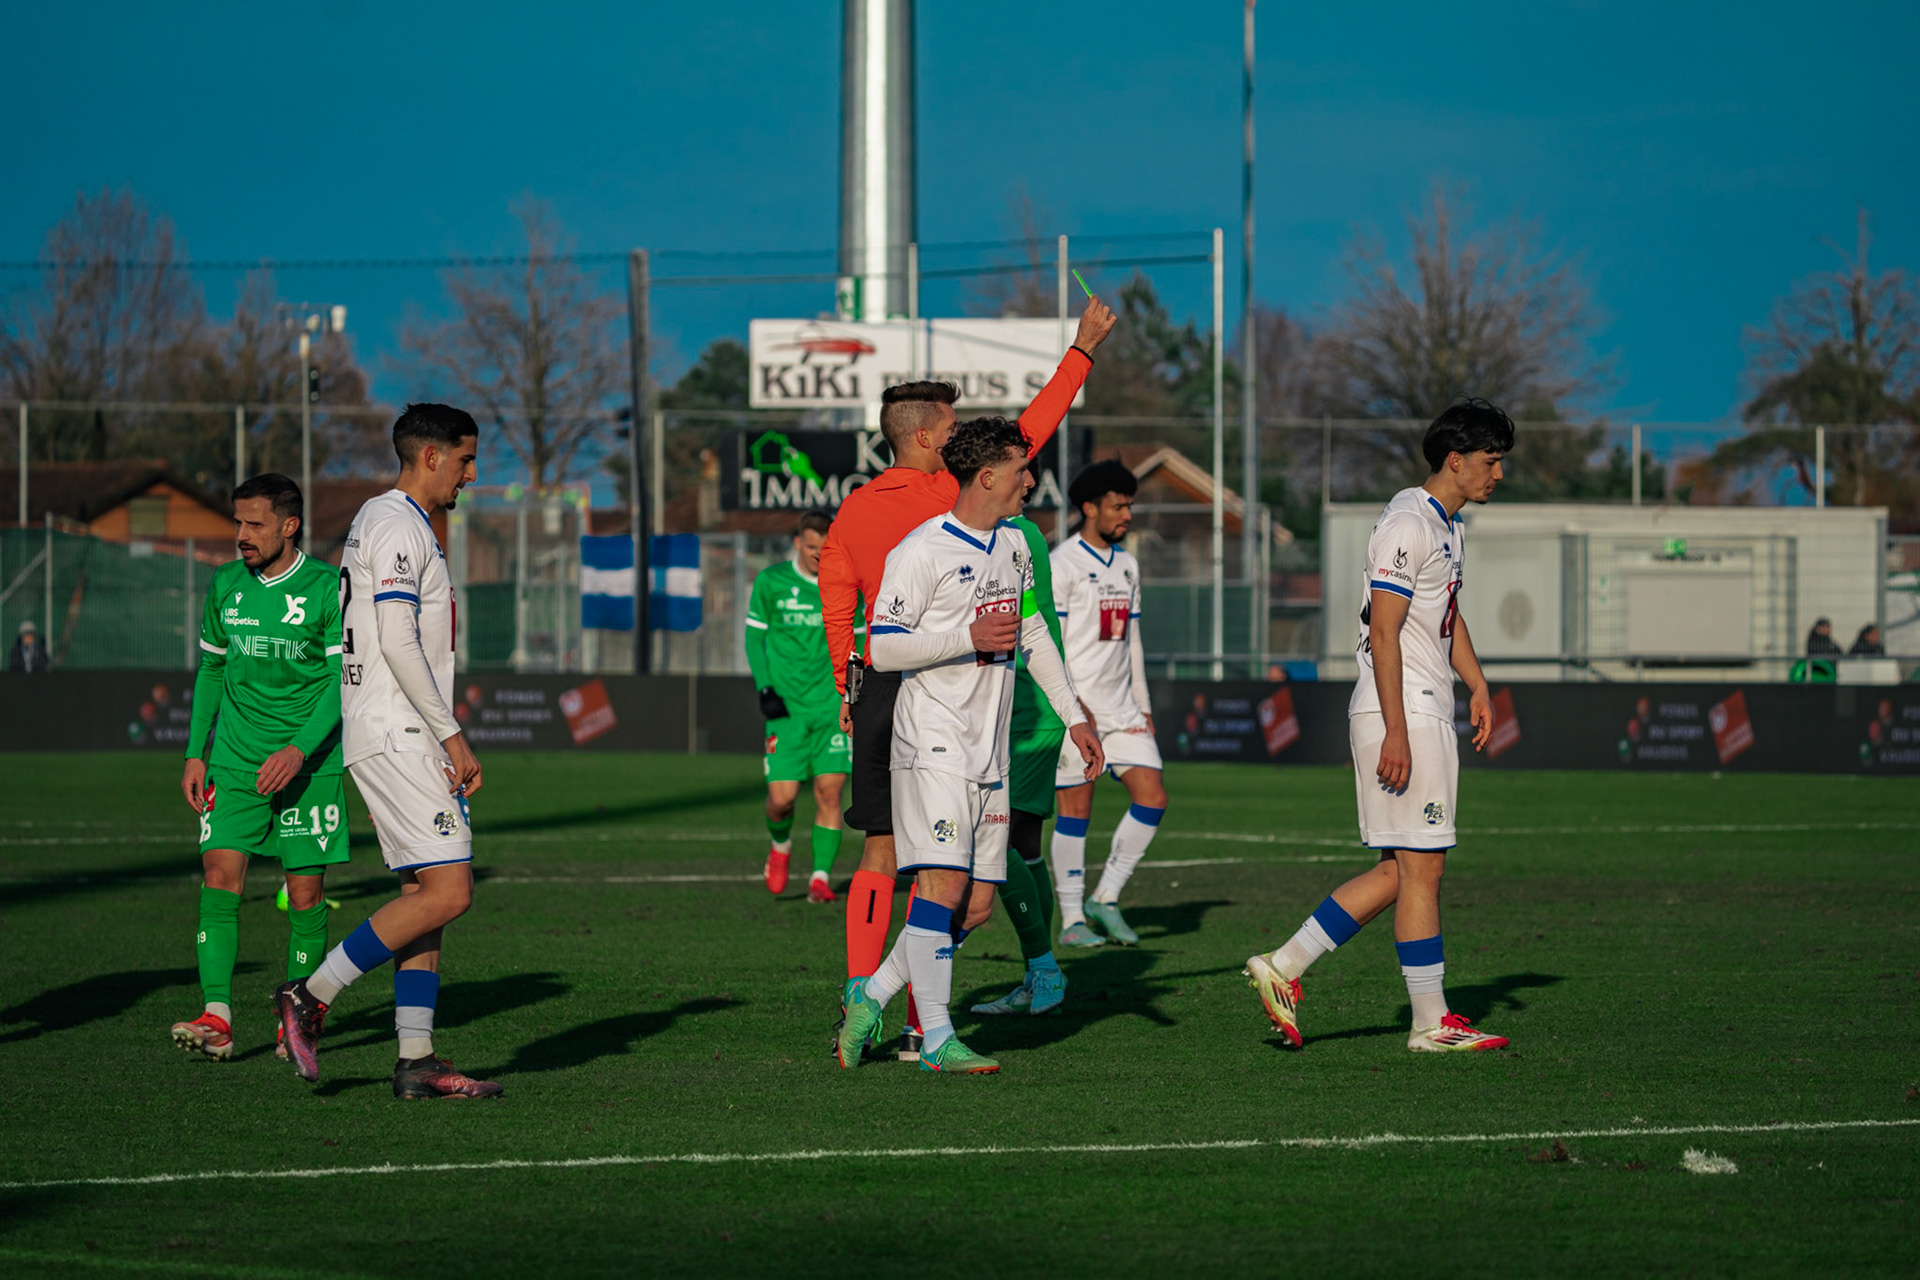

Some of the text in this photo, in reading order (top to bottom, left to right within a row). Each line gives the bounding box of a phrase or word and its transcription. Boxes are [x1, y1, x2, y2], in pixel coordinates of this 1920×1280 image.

[381, 577, 416, 587] mycasin
[309, 804, 339, 835] 19
[197, 931, 206, 944] 19
[296, 950, 307, 964] 19
